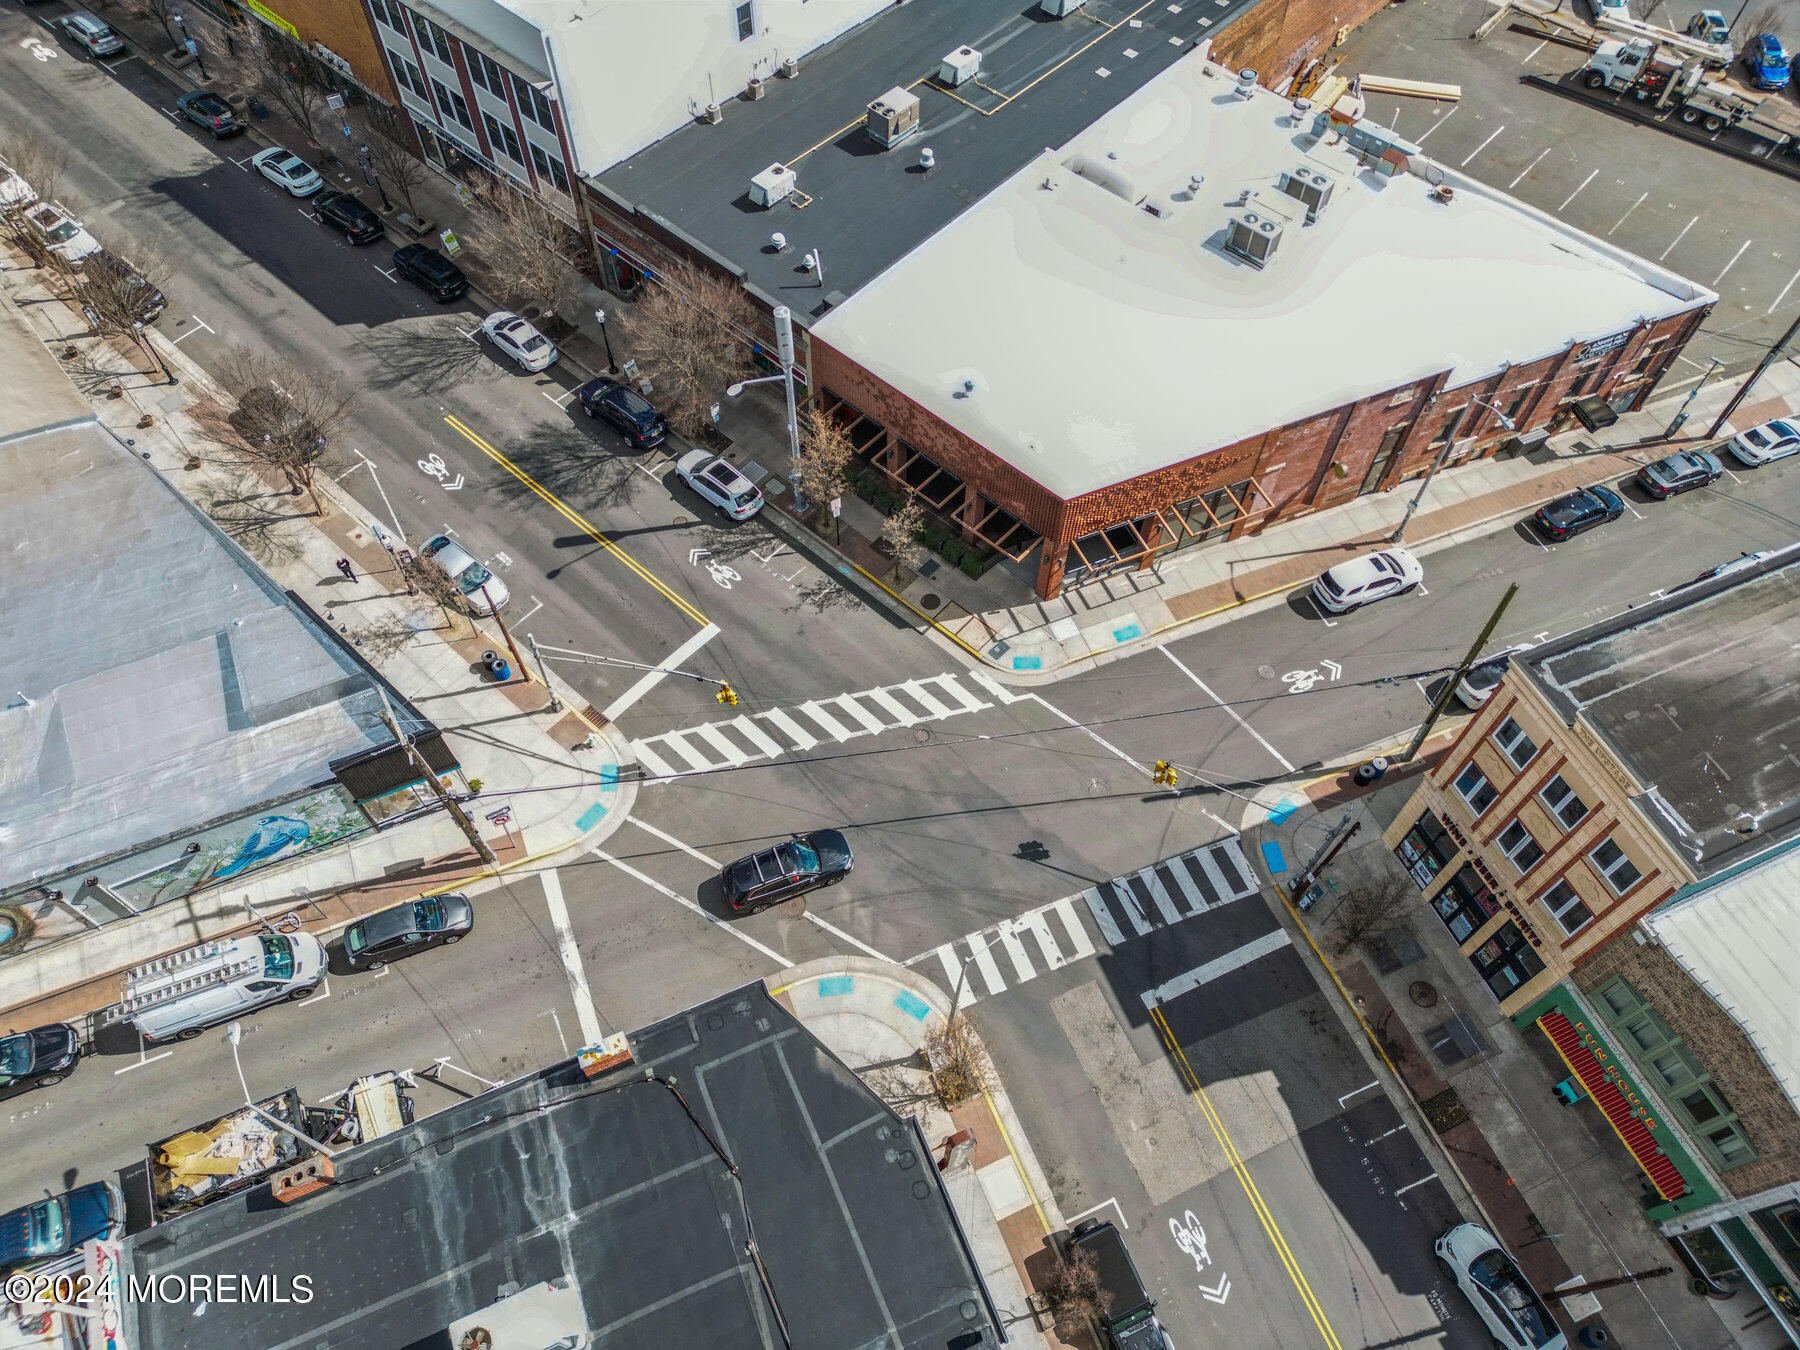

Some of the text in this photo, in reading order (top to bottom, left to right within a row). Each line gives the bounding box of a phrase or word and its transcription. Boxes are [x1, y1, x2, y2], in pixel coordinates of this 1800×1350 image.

[1595, 747, 1631, 789] UPSTAGE
[1473, 858, 1498, 889] BEER
[1505, 900, 1542, 948] SPIRITS
[1575, 1022, 1658, 1130] FUN HOUSE
